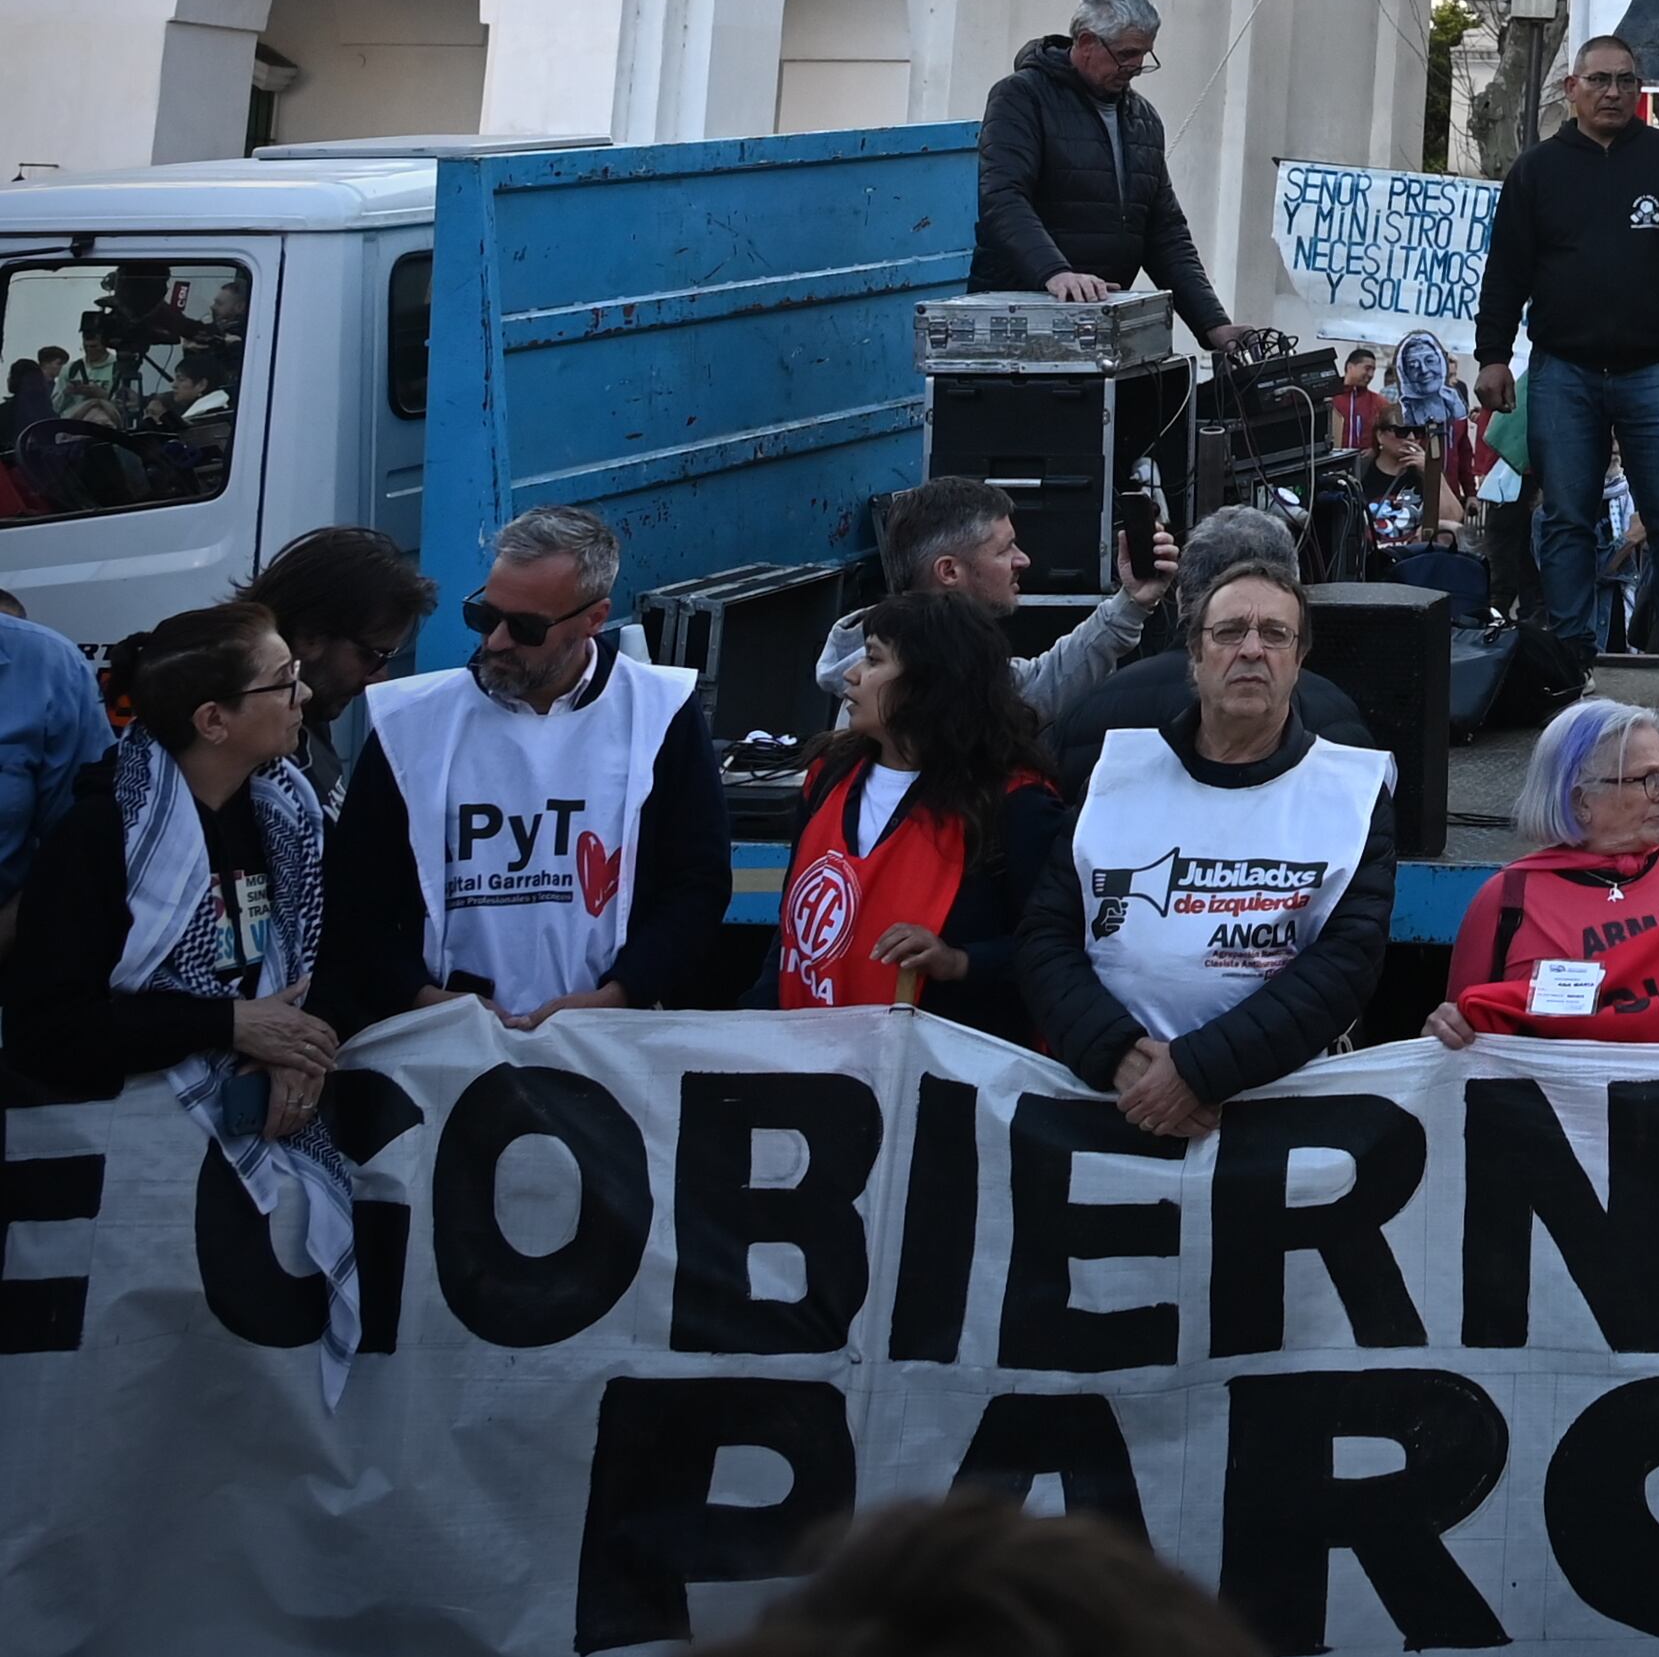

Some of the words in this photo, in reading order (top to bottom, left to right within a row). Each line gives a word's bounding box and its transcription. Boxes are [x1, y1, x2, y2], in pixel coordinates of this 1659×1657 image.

[1283, 201, 1301, 235] Y
[1314, 203, 1454, 250] MINISTRO
[1293, 235, 1484, 287] NECESITAMOS
[1326, 272, 1344, 304] Y
[445, 798, 586, 872] PyT
[488, 870, 573, 891] Garrahan
[1178, 860, 1318, 888] Jubiladxs
[1174, 893, 1206, 914] de
[1207, 891, 1311, 918] izquierda
[1207, 919, 1297, 949] ANCLA
